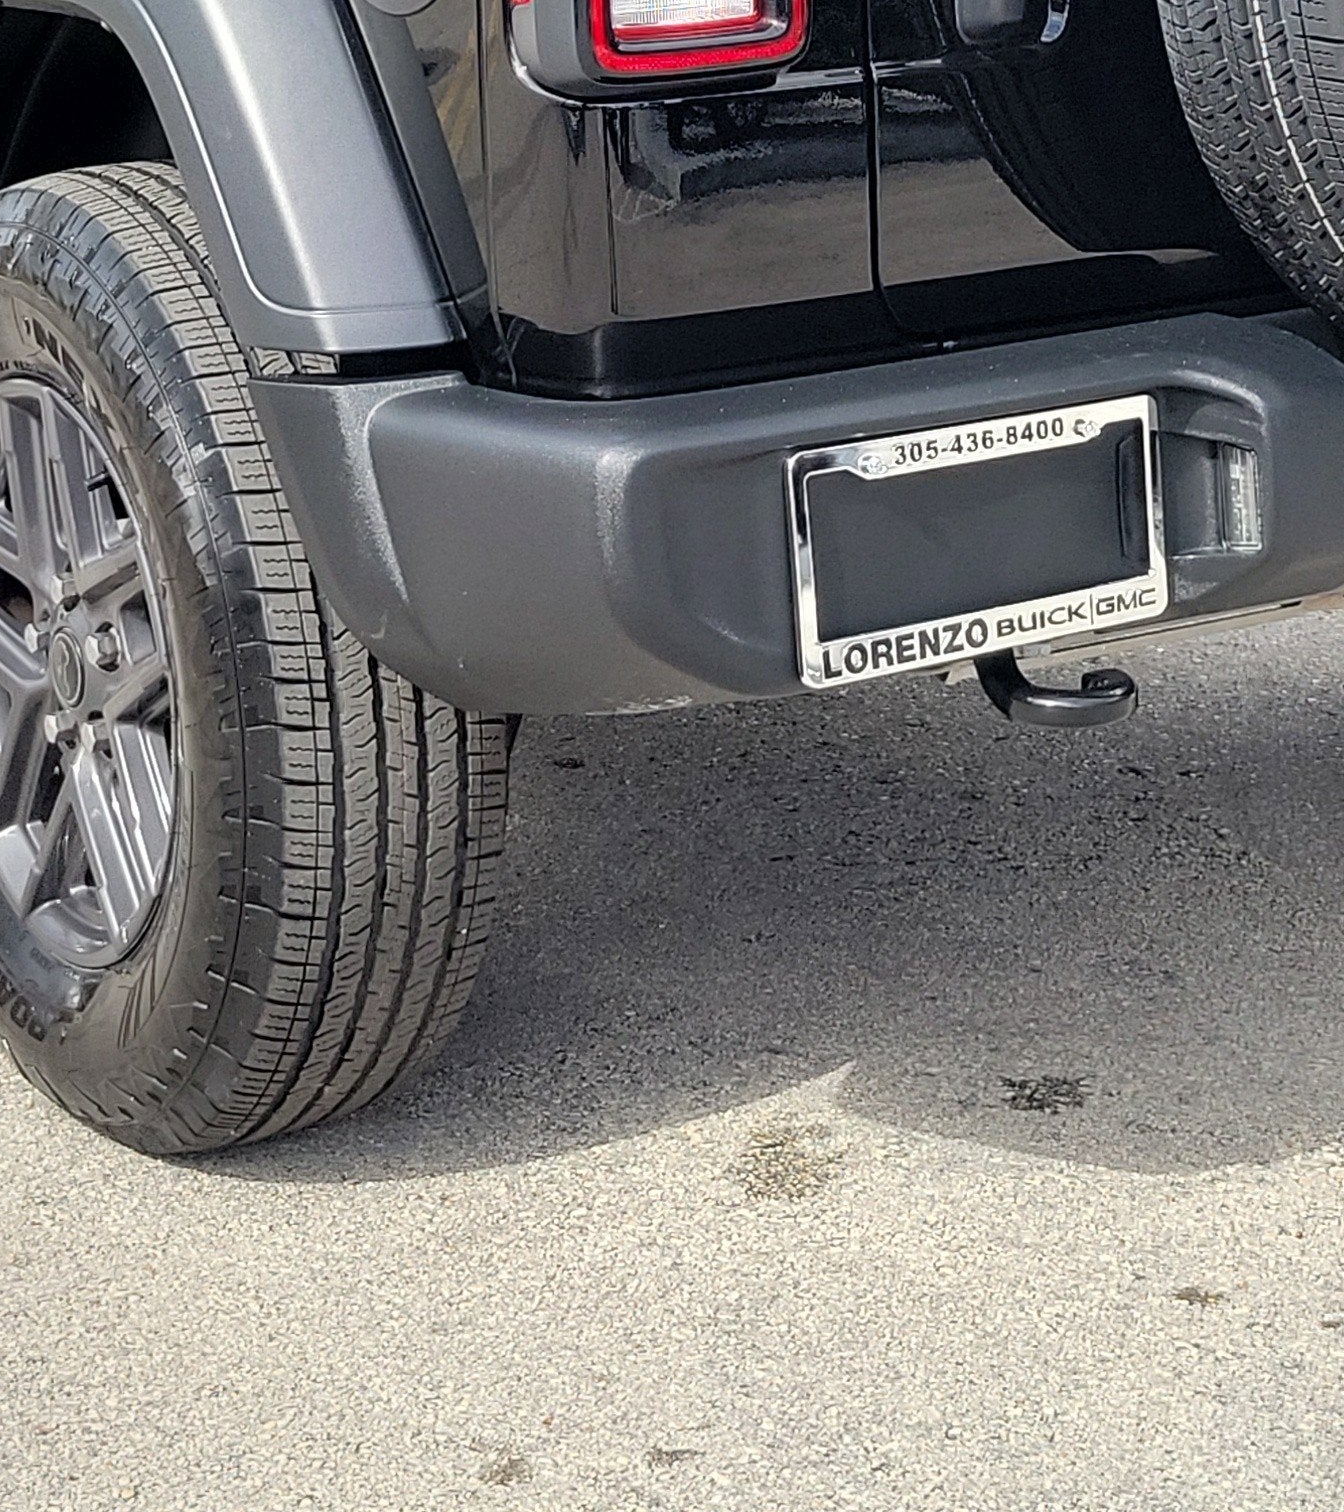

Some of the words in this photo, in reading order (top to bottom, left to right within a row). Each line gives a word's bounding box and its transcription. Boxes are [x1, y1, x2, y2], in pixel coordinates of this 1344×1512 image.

[893, 417, 1064, 466] 305-436-8400
[822, 617, 989, 680] LORENZO
[996, 600, 1087, 638] BUICK
[1095, 587, 1157, 617] GMC
